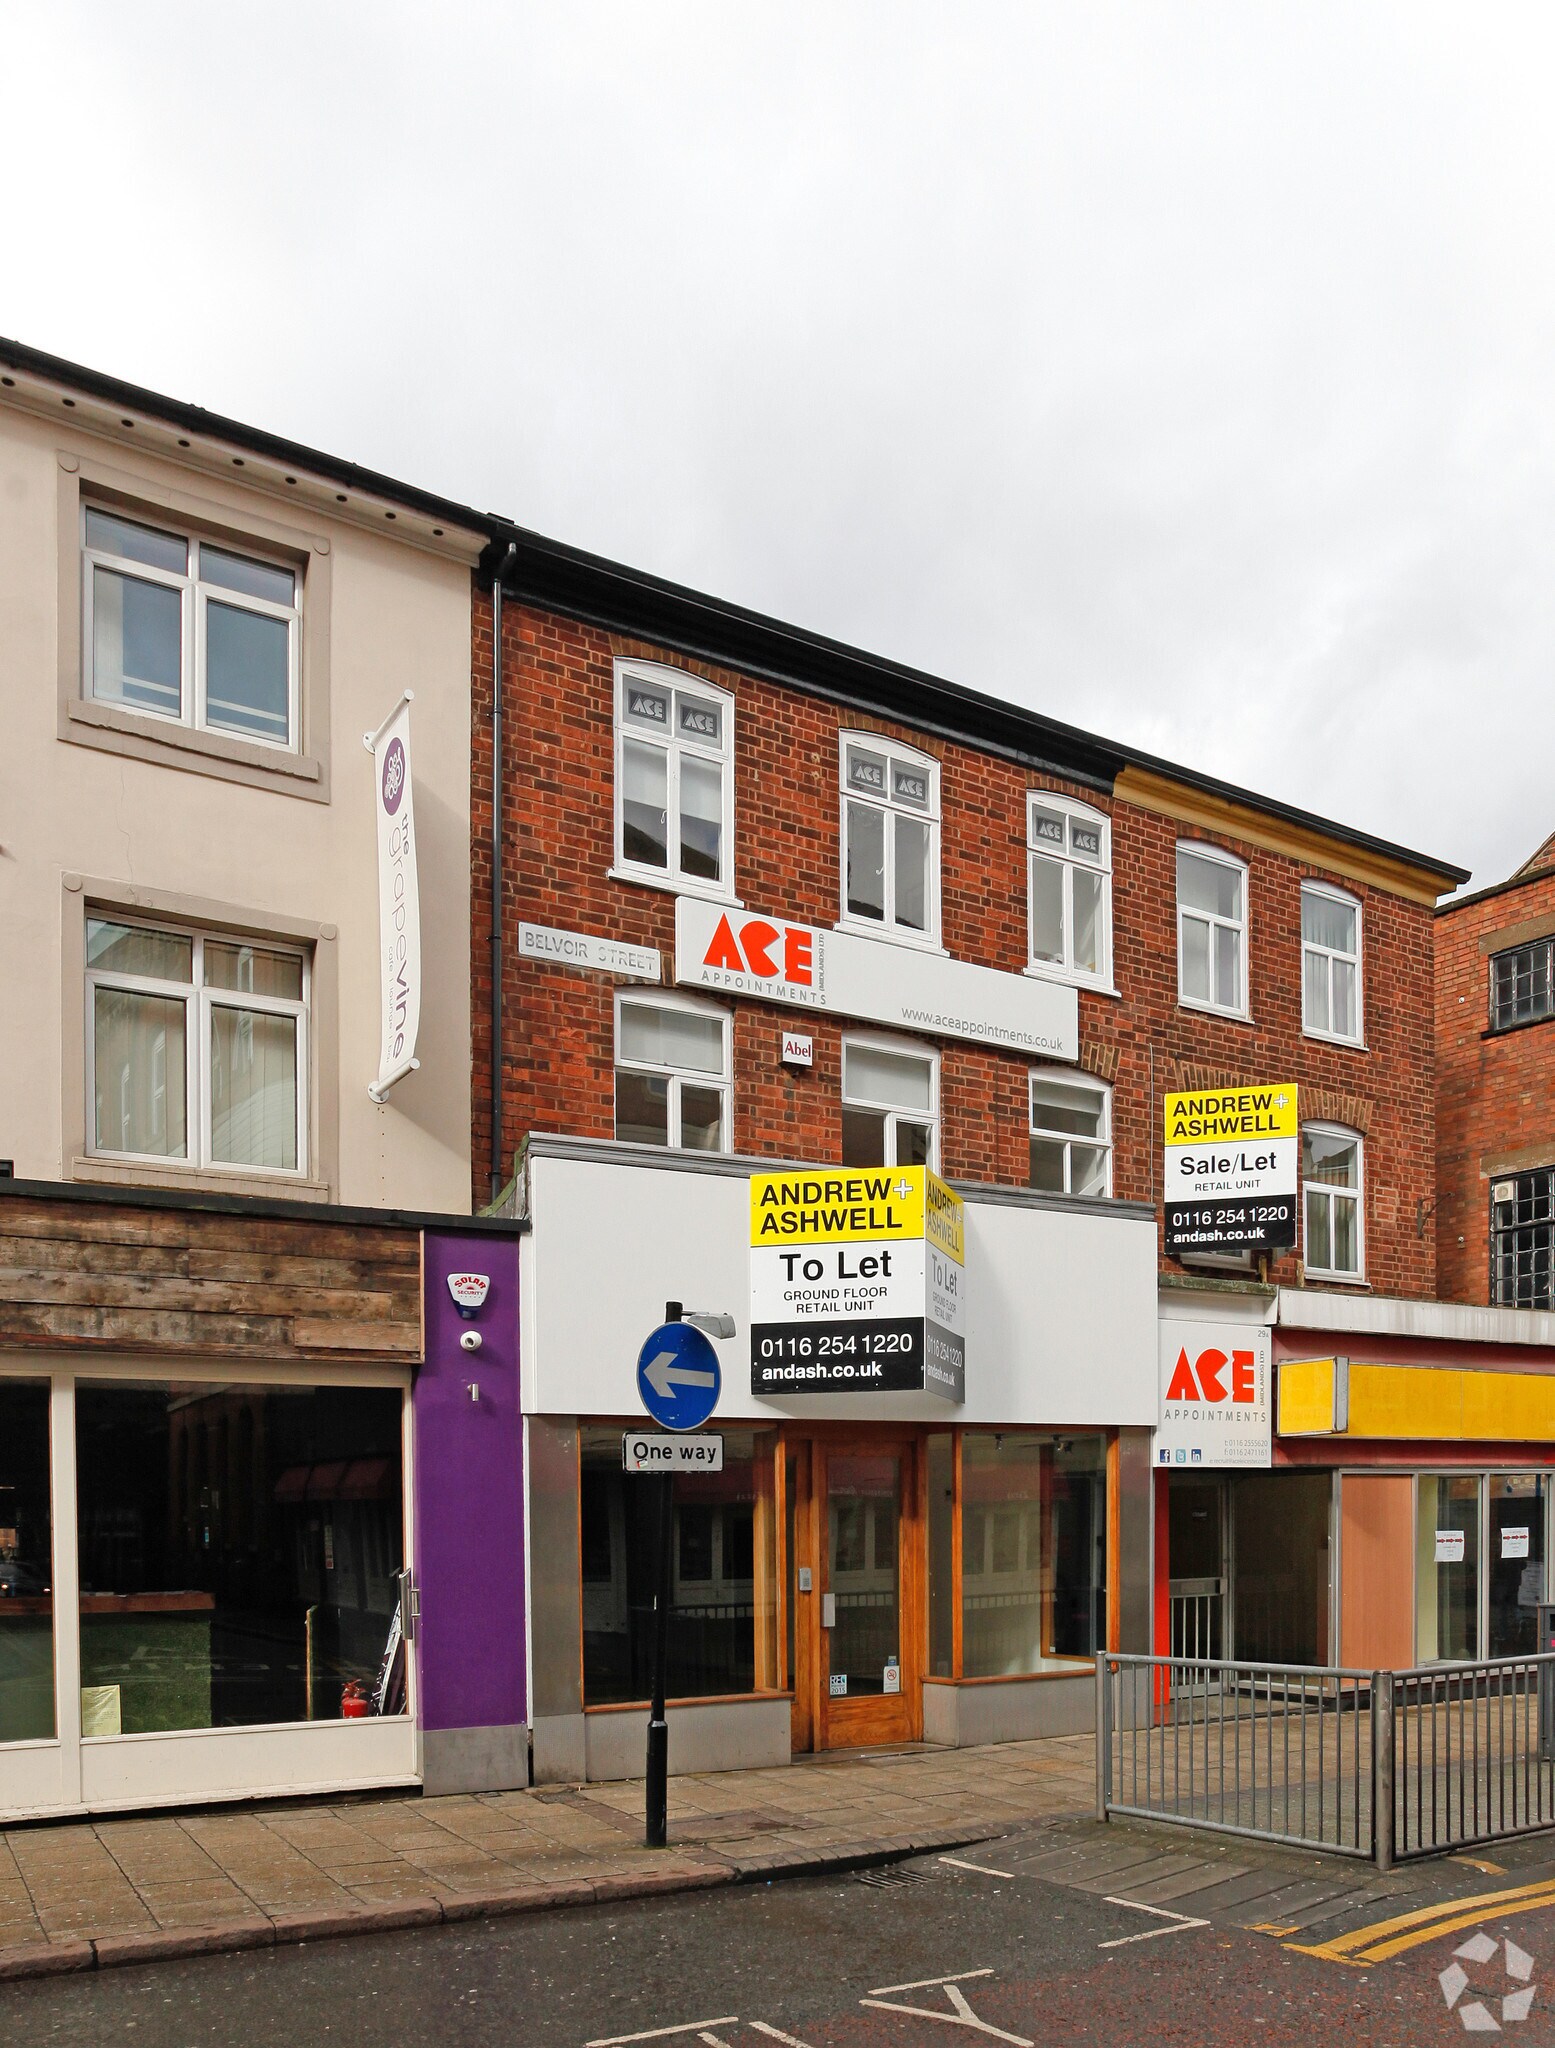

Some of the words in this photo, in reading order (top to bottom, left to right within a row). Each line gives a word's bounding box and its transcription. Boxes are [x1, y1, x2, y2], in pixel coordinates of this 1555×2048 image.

[630, 694, 663, 719] ACE
[682, 710, 714, 733] ACE
[854, 764, 880, 784] ACE
[898, 776, 923, 797] ACE
[401, 813, 410, 855] the
[1039, 822, 1060, 840] ACE
[1075, 831, 1097, 851] ACE
[388, 826, 410, 1059] grapevine
[525, 931, 589, 958] BELVOIR
[598, 946, 656, 971] STREET
[702, 912, 813, 987] ACE
[701, 969, 827, 1005] APPOINTMENTS
[901, 1007, 1064, 1051] www.aceappointments.co.uk
[784, 1041, 812, 1058] Abel
[1172, 1114, 1281, 1138] ASHWELL
[1179, 1151, 1277, 1176] Sale/Let
[1194, 1181, 1233, 1192] RETAIL
[1235, 1179, 1262, 1190] UNIT
[760, 1206, 903, 1235] ASHWELL
[1172, 1211, 1212, 1227] 0116
[1216, 1208, 1246, 1225] 254
[1248, 1206, 1289, 1223] 1220
[927, 1208, 960, 1253] ASHWELL
[1173, 1227, 1266, 1244] andash.co.uk
[779, 1253, 824, 1282] To
[838, 1250, 892, 1280] Let
[931, 1252, 942, 1287] To
[944, 1262, 958, 1297] Let
[454, 1276, 487, 1289] SOLAR
[783, 1288, 840, 1301] GROUND
[843, 1286, 888, 1299] FLOOR
[796, 1301, 841, 1314] RETAIL
[844, 1300, 875, 1312] UNIT
[761, 1337, 812, 1358] 0116
[818, 1335, 857, 1356] 254
[861, 1333, 913, 1354] 1220
[762, 1361, 883, 1380] andash.co.uk
[1165, 1345, 1255, 1403] ACE
[1164, 1408, 1267, 1423] APPOINTMENTS
[633, 1441, 673, 1459] One
[679, 1447, 717, 1464] way
